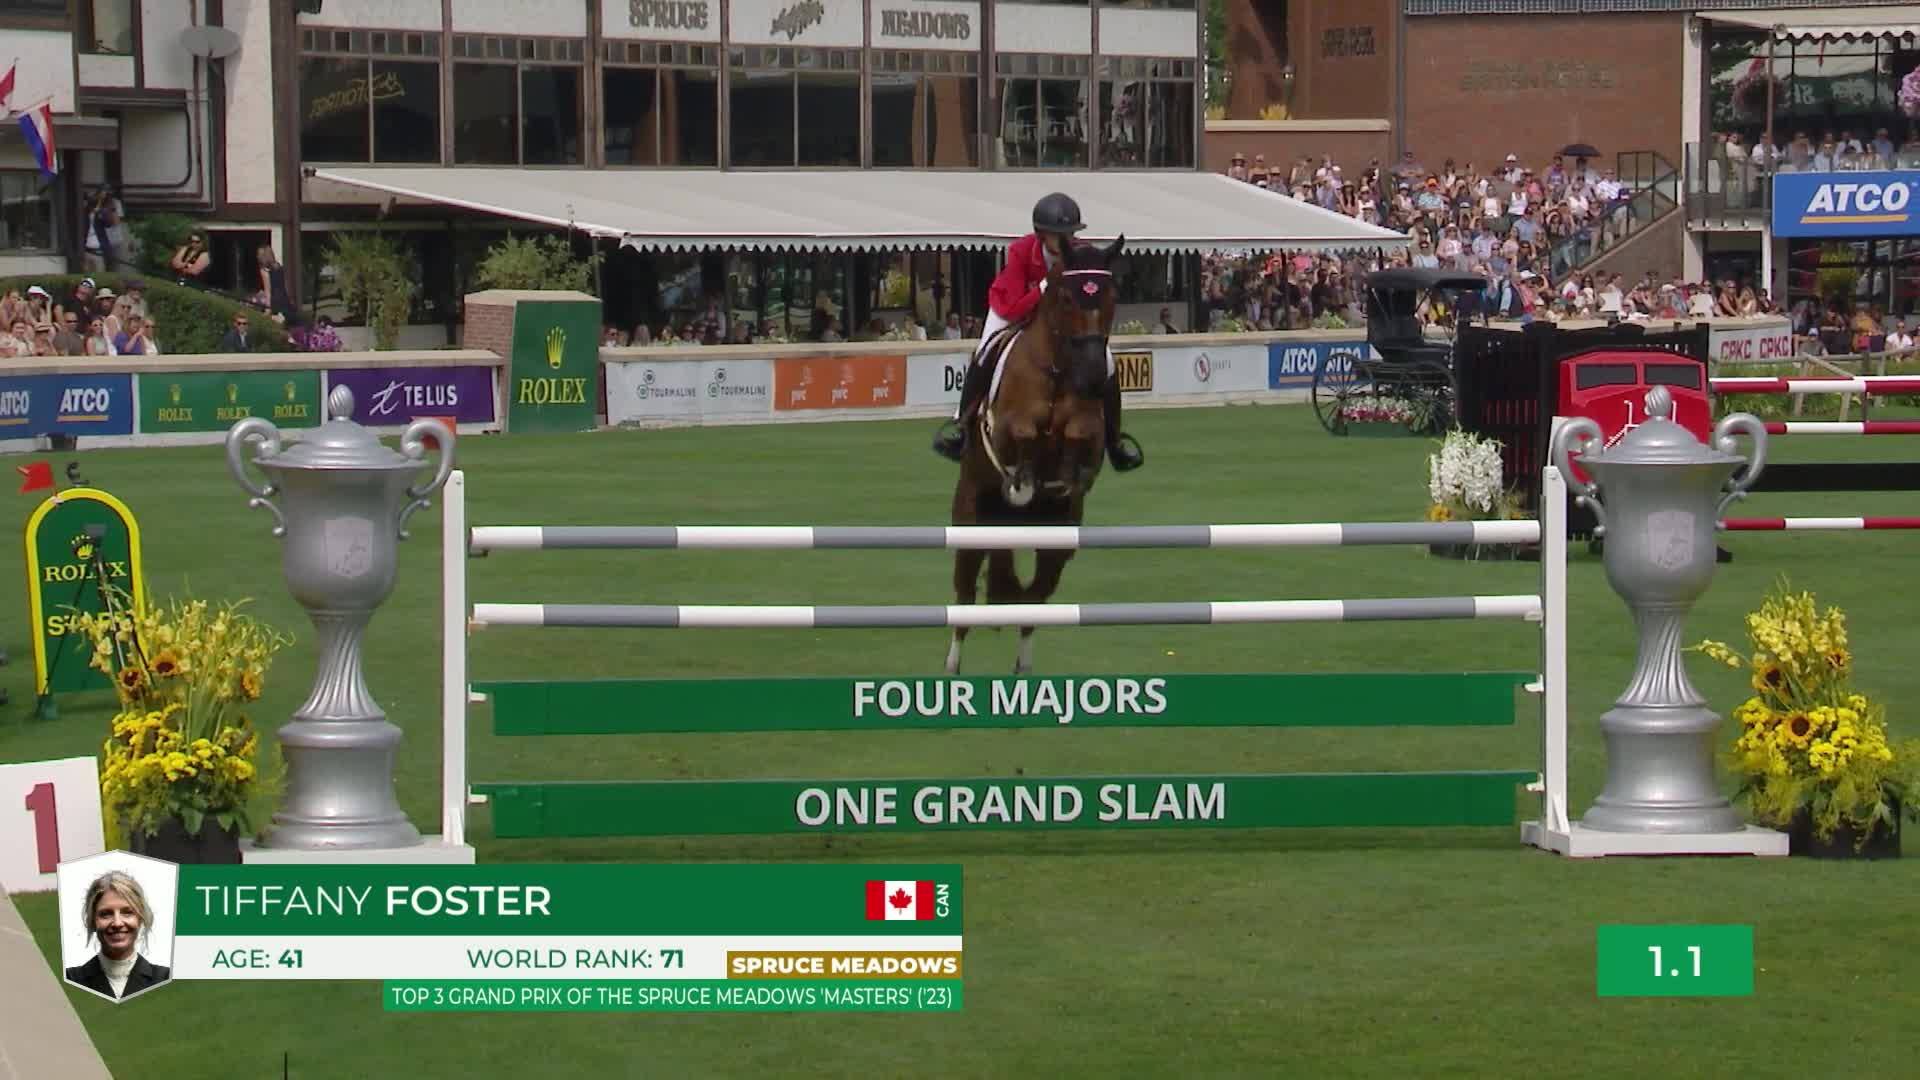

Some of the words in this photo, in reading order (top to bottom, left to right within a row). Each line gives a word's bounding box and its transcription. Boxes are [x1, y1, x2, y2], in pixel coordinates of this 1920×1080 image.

[881, 10, 970, 40] MEADOWS
[1806, 182, 1910, 213] ATCO
[1281, 347, 1317, 374] ATCO
[0, 391, 30, 416] ATCO
[60, 388, 109, 413] ATCO
[404, 384, 457, 406] TELUS
[518, 378, 587, 404] ROLEX
[650, 387, 697, 399] TOURMALINE
[720, 385, 767, 397] TOURMALINE
[158, 407, 193, 422] ROLEX
[216, 406, 250, 420] ROLEX
[273, 404, 309, 418] ROLEX
[44, 561, 128, 582] ROLX
[853, 681, 977, 717] FOUR
[990, 678, 1168, 724] MAJORS
[795, 787, 898, 826] ONE
[912, 785, 1084, 825] GRAND
[1098, 783, 1226, 822] SLAM
[25, 782, 61, 873] 1
